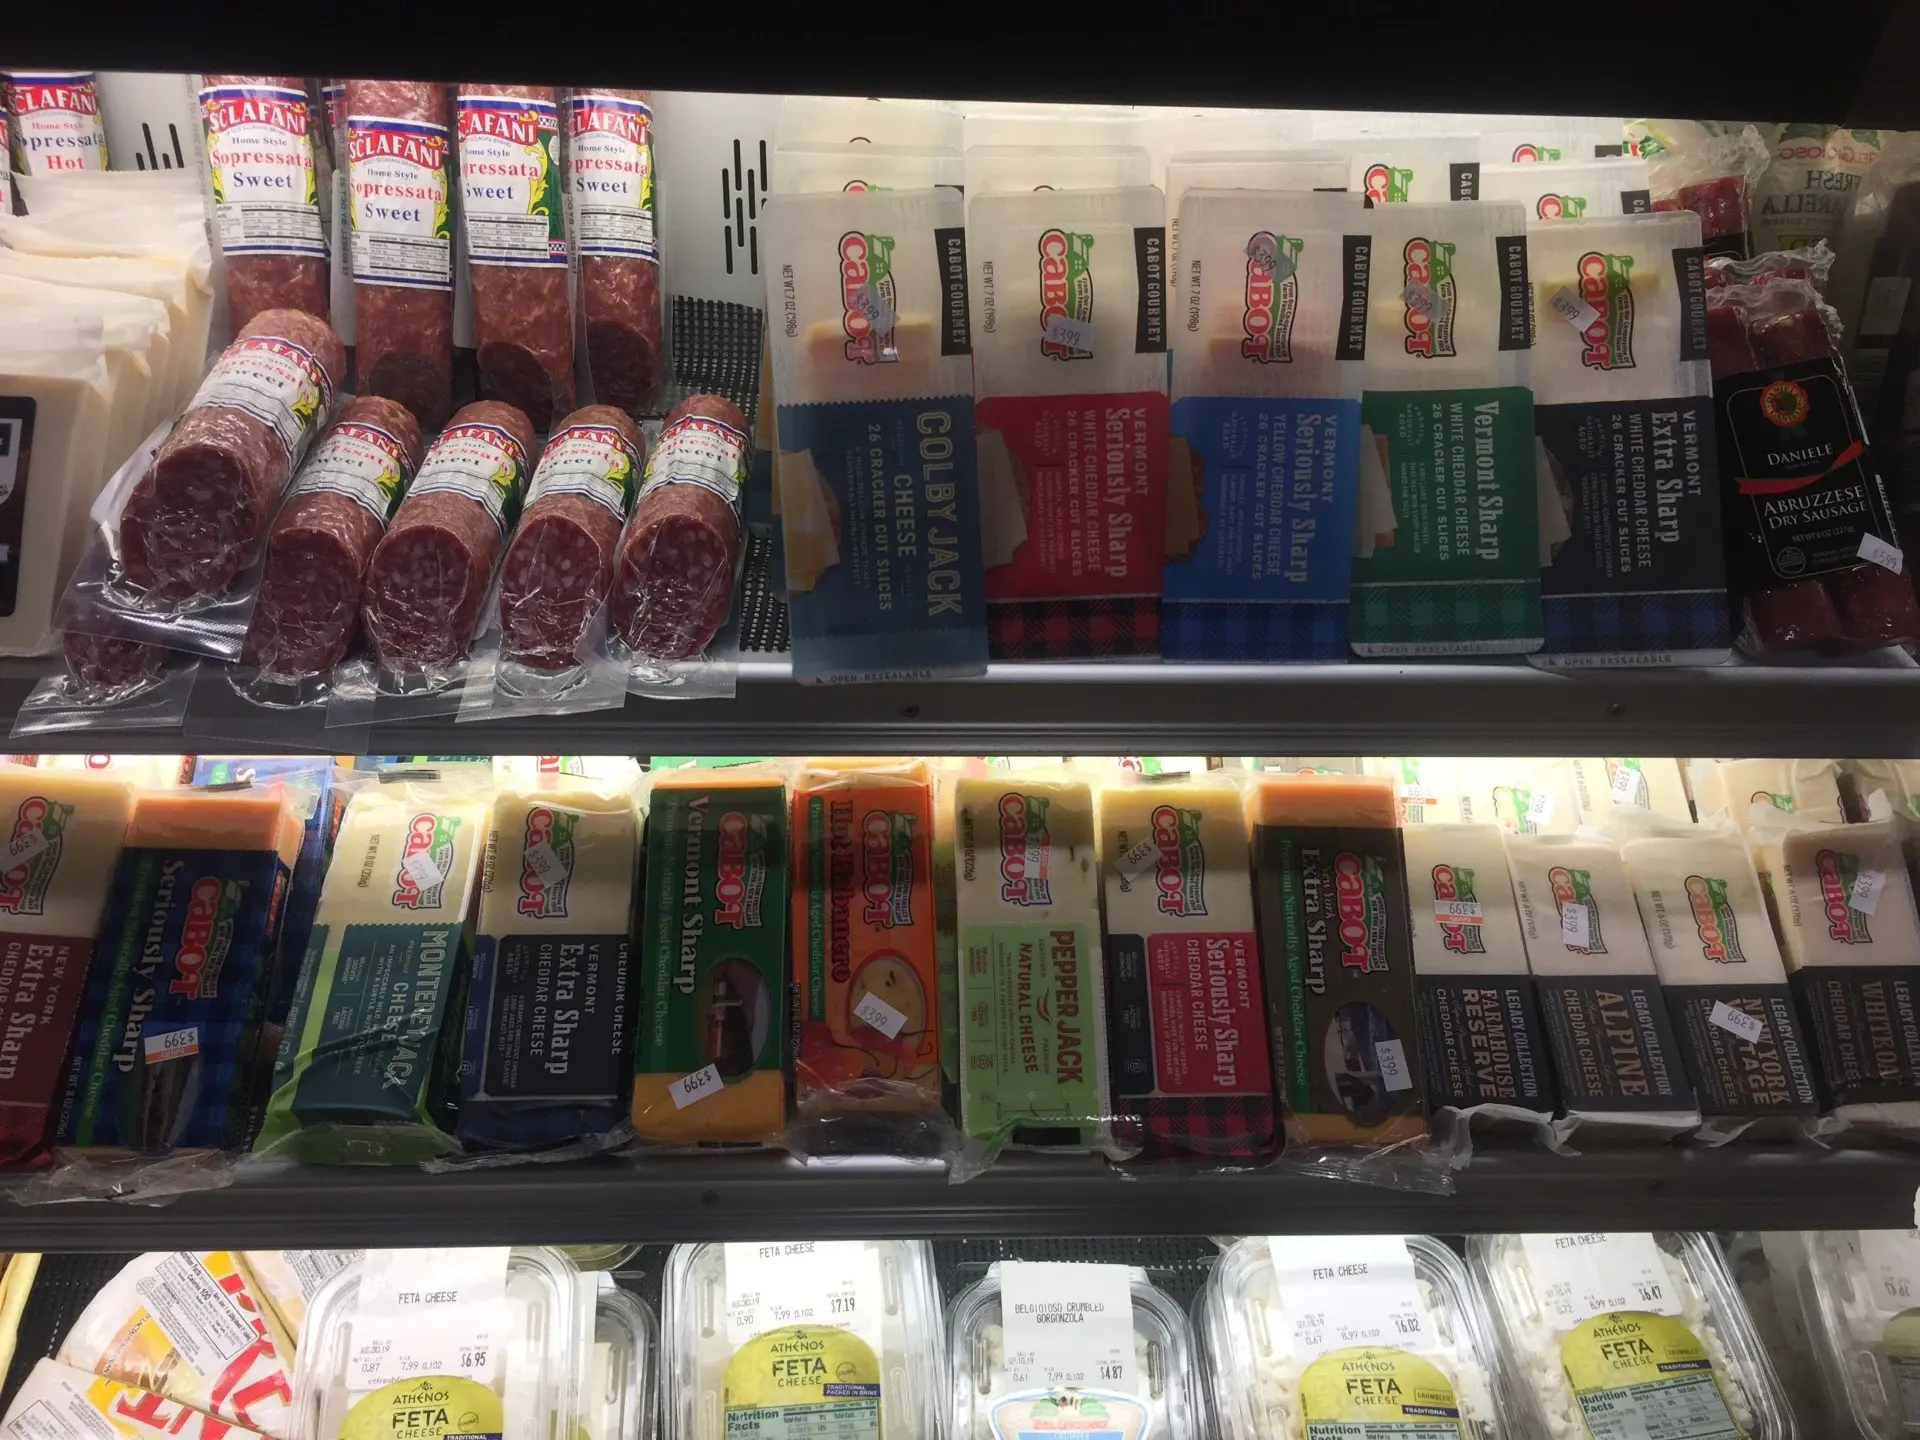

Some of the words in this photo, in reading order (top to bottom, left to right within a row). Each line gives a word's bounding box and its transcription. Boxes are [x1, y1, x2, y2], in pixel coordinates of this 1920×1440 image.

[209, 101, 307, 136] SCLAFANI
[232, 136, 260, 145] Home
[263, 137, 288, 147] Style
[45, 155, 85, 170] Hot
[212, 151, 313, 169] Sopressata
[394, 170, 419, 180] Style
[578, 145, 601, 153] Home
[604, 146, 627, 155] Style
[233, 172, 293, 189] Sweet
[576, 178, 629, 195] Sweet
[365, 202, 421, 222] Sweet
[948, 238, 963, 282] CABOT
[1147, 238, 1159, 281] CABOT
[1352, 246, 1368, 287] CABOT
[1508, 245, 1522, 285] CABOT
[1686, 257, 1702, 296] CABOT
[950, 283, 966, 345] GOURMET
[1147, 283, 1160, 343] GOURMET
[1349, 288, 1366, 350] GOURMET
[1511, 286, 1524, 341] GOURMET
[1690, 297, 1706, 351] GOURMET
[867, 424, 881, 442] 26
[1083, 409, 1098, 451] WHITE
[1272, 414, 1287, 463] YELLOW
[1450, 402, 1464, 442] WHITE
[1473, 400, 1500, 491] Vermont
[1629, 412, 1644, 453] WHITE
[1651, 410, 1679, 471] Extra
[916, 411, 957, 523] COLBY
[1067, 431, 1080, 496] CRACKER
[1103, 408, 1132, 507] Seriously
[1133, 407, 1148, 496] VERMONT
[1256, 435, 1268, 498] CRACKER
[1288, 413, 1322, 512] Seriously
[1321, 414, 1338, 504] VERMONT
[1433, 424, 1445, 484] CRACKER
[1451, 445, 1467, 505] CHEDDAR
[1613, 434, 1626, 495] CRACKER
[1682, 409, 1702, 496] VERMONT
[1766, 443, 1834, 467] DANIELE
[869, 447, 887, 519] CRACKER
[1084, 455, 1099, 517] CHEDDAR
[1269, 466, 1285, 525] CHEDDAR
[1631, 455, 1648, 516] CHEDDAR
[1763, 484, 1866, 517] ABRUZZESE
[893, 474, 917, 557] CHEESE
[1454, 507, 1470, 556] CHEESE
[1475, 495, 1504, 561] Sharp
[1616, 499, 1629, 523] CUT
[1654, 478, 1684, 544] Sharp
[1769, 514, 1799, 530] DRY
[1803, 500, 1868, 523] SAUSAGE
[1086, 521, 1101, 572] CHEESE
[1105, 512, 1132, 578] Sharp
[1266, 527, 1283, 576] CHEESE
[1284, 518, 1317, 583] Sharp
[1437, 515, 1450, 562] SLICES
[1618, 527, 1631, 573] SLICES
[1635, 518, 1651, 568] CHEESE
[876, 559, 892, 611] SLICES
[926, 526, 963, 618] JACK
[681, 794, 710, 908] Vermont
[1301, 847, 1321, 914] Extra
[132, 859, 186, 980] Seriously
[14, 943, 55, 1004] Extra
[52, 945, 71, 979] NEW
[534, 942, 553, 1003] CHEDDAR
[555, 942, 585, 1001] Extra
[672, 908, 705, 996] Sharp
[1050, 930, 1081, 1019] PEPPER
[1186, 939, 1204, 1006] CHEDDAR
[1233, 938, 1250, 1009] VERMONT
[1304, 919, 1328, 994] Sharp
[406, 930, 450, 1035] MONTEREY
[584, 943, 600, 1015] VERMONT
[1017, 943, 1034, 1016] NATURAL
[1204, 938, 1237, 1025] Seriously
[40, 984, 62, 1026] YORK
[112, 987, 156, 1073] Sharp
[381, 982, 410, 1041] CHEESE
[861, 1005, 888, 1028] $399
[1193, 1009, 1209, 1051] CHEESE
[1504, 989, 1525, 1031] LEGACY
[1727, 1009, 1756, 1033] $399
[1826, 980, 1851, 1041] CHEDDAR
[1861, 981, 1895, 1047] WHITE
[164, 1031, 196, 1049] $399
[529, 1006, 548, 1057] CHEESE
[544, 1009, 580, 1075] Sharp
[1018, 1016, 1039, 1074] CHEESE
[1056, 1019, 1084, 1086] JACK
[1436, 989, 1455, 1046] CHEDDAR
[1447, 1047, 1464, 1098] CHEESE
[1462, 989, 1497, 1098] RESERVE
[1479, 989, 1517, 1099] FARMHOUSE
[1563, 989, 1588, 1047] CHEDDAR
[1579, 1047, 1604, 1098] CHEESE
[1595, 989, 1650, 1097] ALPINE
[1630, 989, 1652, 1030] LEGACY
[1642, 1029, 1673, 1097] COLLECTION
[1769, 997, 1793, 1039] LEGACY
[1783, 1038, 1814, 1105] COLLECTION
[381, 1035, 422, 1090] JACK
[683, 1070, 713, 1093] $399
[1213, 1027, 1240, 1087] Sharp
[1380, 1047, 1398, 1077] $399
[1513, 1031, 1538, 1098] COLLECTION
[1716, 1057, 1740, 1107] CHEESE
[1757, 1048, 1792, 1106] YORK
[759, 1246, 781, 1259] FETA
[784, 1242, 816, 1256] CHEESE
[1555, 1237, 1576, 1249] FETA
[1578, 1233, 1608, 1245] CHEESE
[1312, 1268, 1335, 1280] FETA
[1338, 1263, 1369, 1277] CHEESE
[398, 1292, 421, 1304] FETA
[424, 1291, 458, 1303] CHEESE
[736, 1315, 754, 1327] 0.90
[774, 1310, 791, 1321] 7.99
[830, 1297, 856, 1314] $7.19
[1014, 1303, 1063, 1314] BELGIOIOSO
[1066, 1303, 1105, 1312] CRUMBLED
[1036, 1313, 1084, 1324] GORGONZOLA
[1589, 1300, 1606, 1310] 8.99
[770, 1340, 825, 1353] ATHENOS
[1341, 1330, 1359, 1341] 8.99
[1394, 1319, 1421, 1334] $6.02
[1593, 1322, 1642, 1338] ATHENOS
[1600, 1338, 1655, 1362] FETA
[361, 1363, 381, 1373] 0.87
[401, 1361, 419, 1371] 7.99
[460, 1352, 487, 1368] $6.95
[772, 1357, 828, 1378] FETA
[777, 1376, 823, 1388] CHEESE
[1047, 1373, 1064, 1381] 7.99
[1100, 1365, 1123, 1380] $4.87
[1341, 1360, 1396, 1372] ATHENOS
[1345, 1378, 1403, 1396] FETA
[1613, 1356, 1653, 1370] CHEESE
[392, 1392, 450, 1405] ATHENOS
[392, 1408, 450, 1429] FETA
[726, 1410, 779, 1422] Nutrition
[1354, 1395, 1399, 1405] CHEESE
[1404, 1407, 1448, 1416] TRADITIONAL
[1579, 1389, 1629, 1405] Nutrition
[1583, 1402, 1615, 1415] Facts
[396, 1427, 442, 1439] CHEESE
[726, 1422, 761, 1432] Facts
[1309, 1424, 1361, 1436] Nutrition
